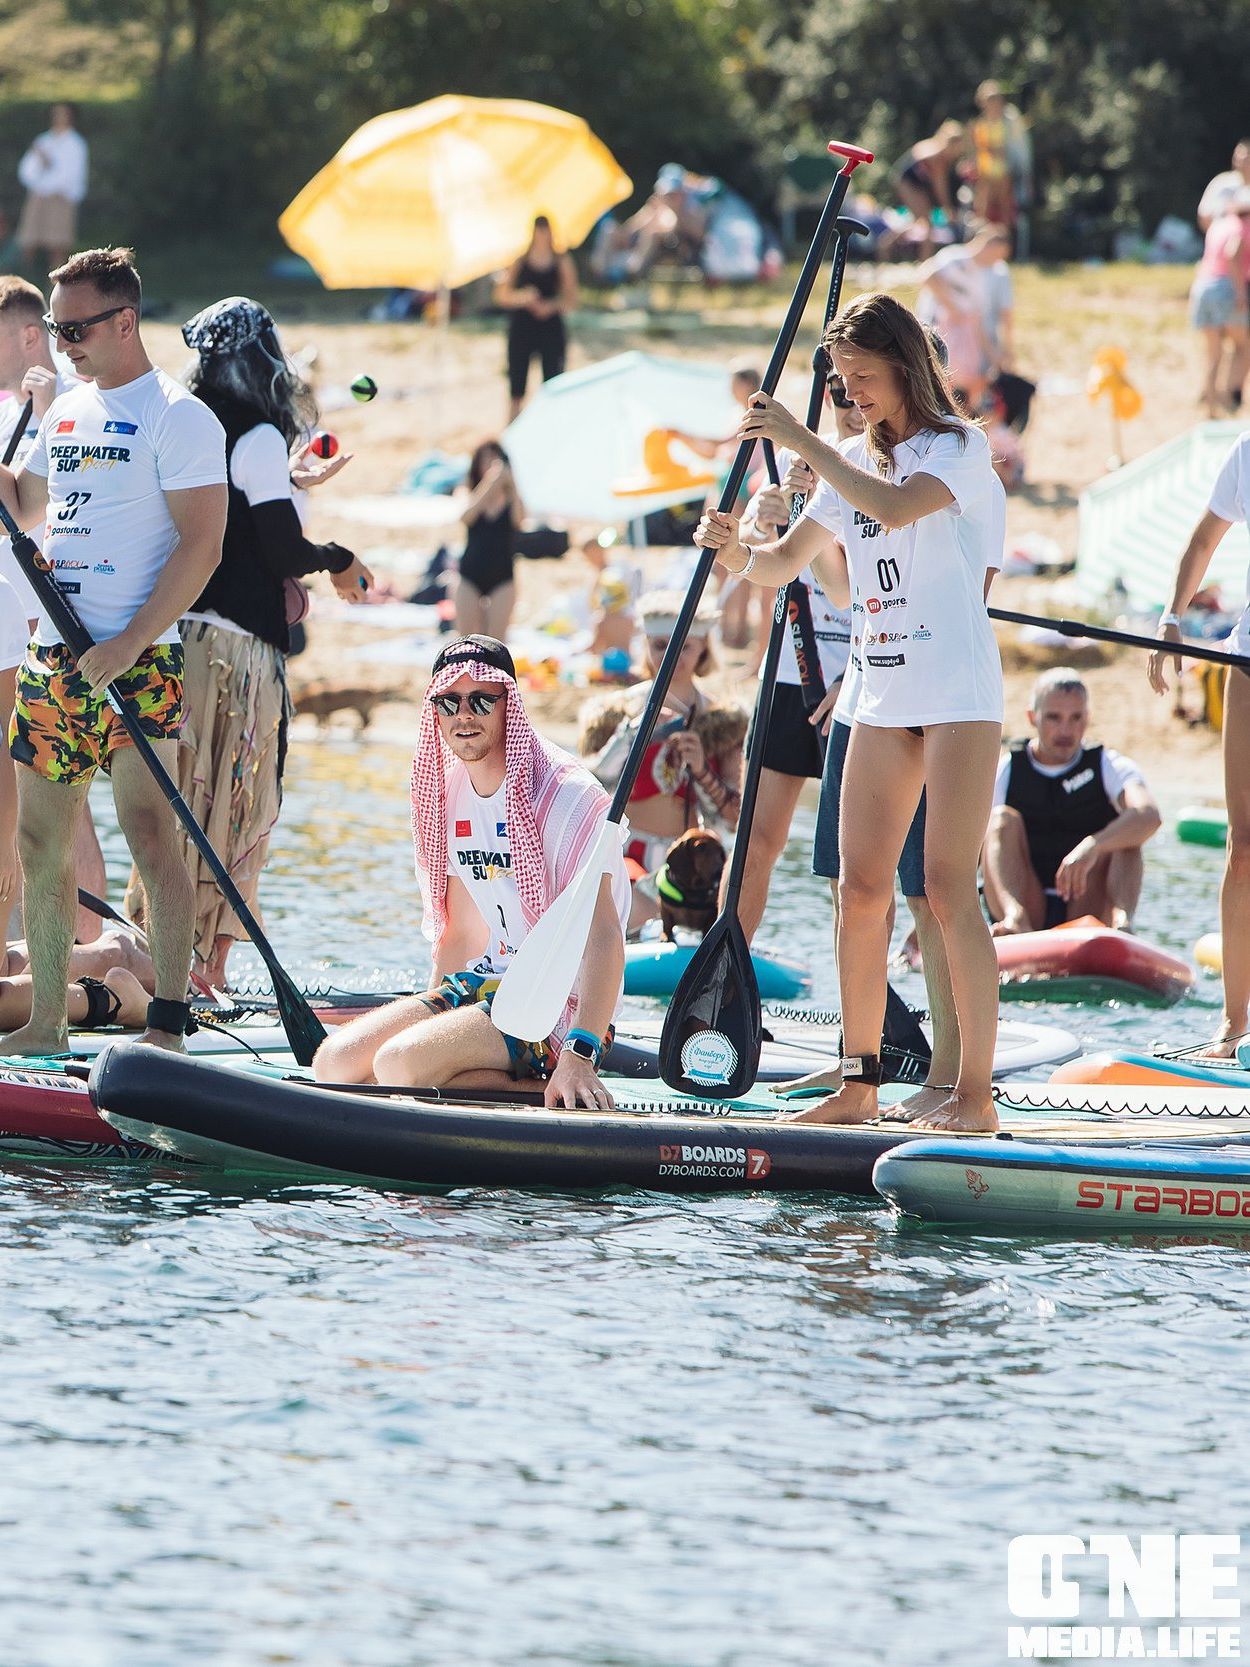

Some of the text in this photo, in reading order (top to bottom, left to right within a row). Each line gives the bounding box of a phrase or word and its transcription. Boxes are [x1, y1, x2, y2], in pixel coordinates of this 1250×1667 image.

[50, 445, 131, 463] DEEP WATER
[876, 557, 901, 593] 01
[658, 1144, 747, 1164] D7BOARDS
[658, 1164, 745, 1178] D7BOARDS.COM
